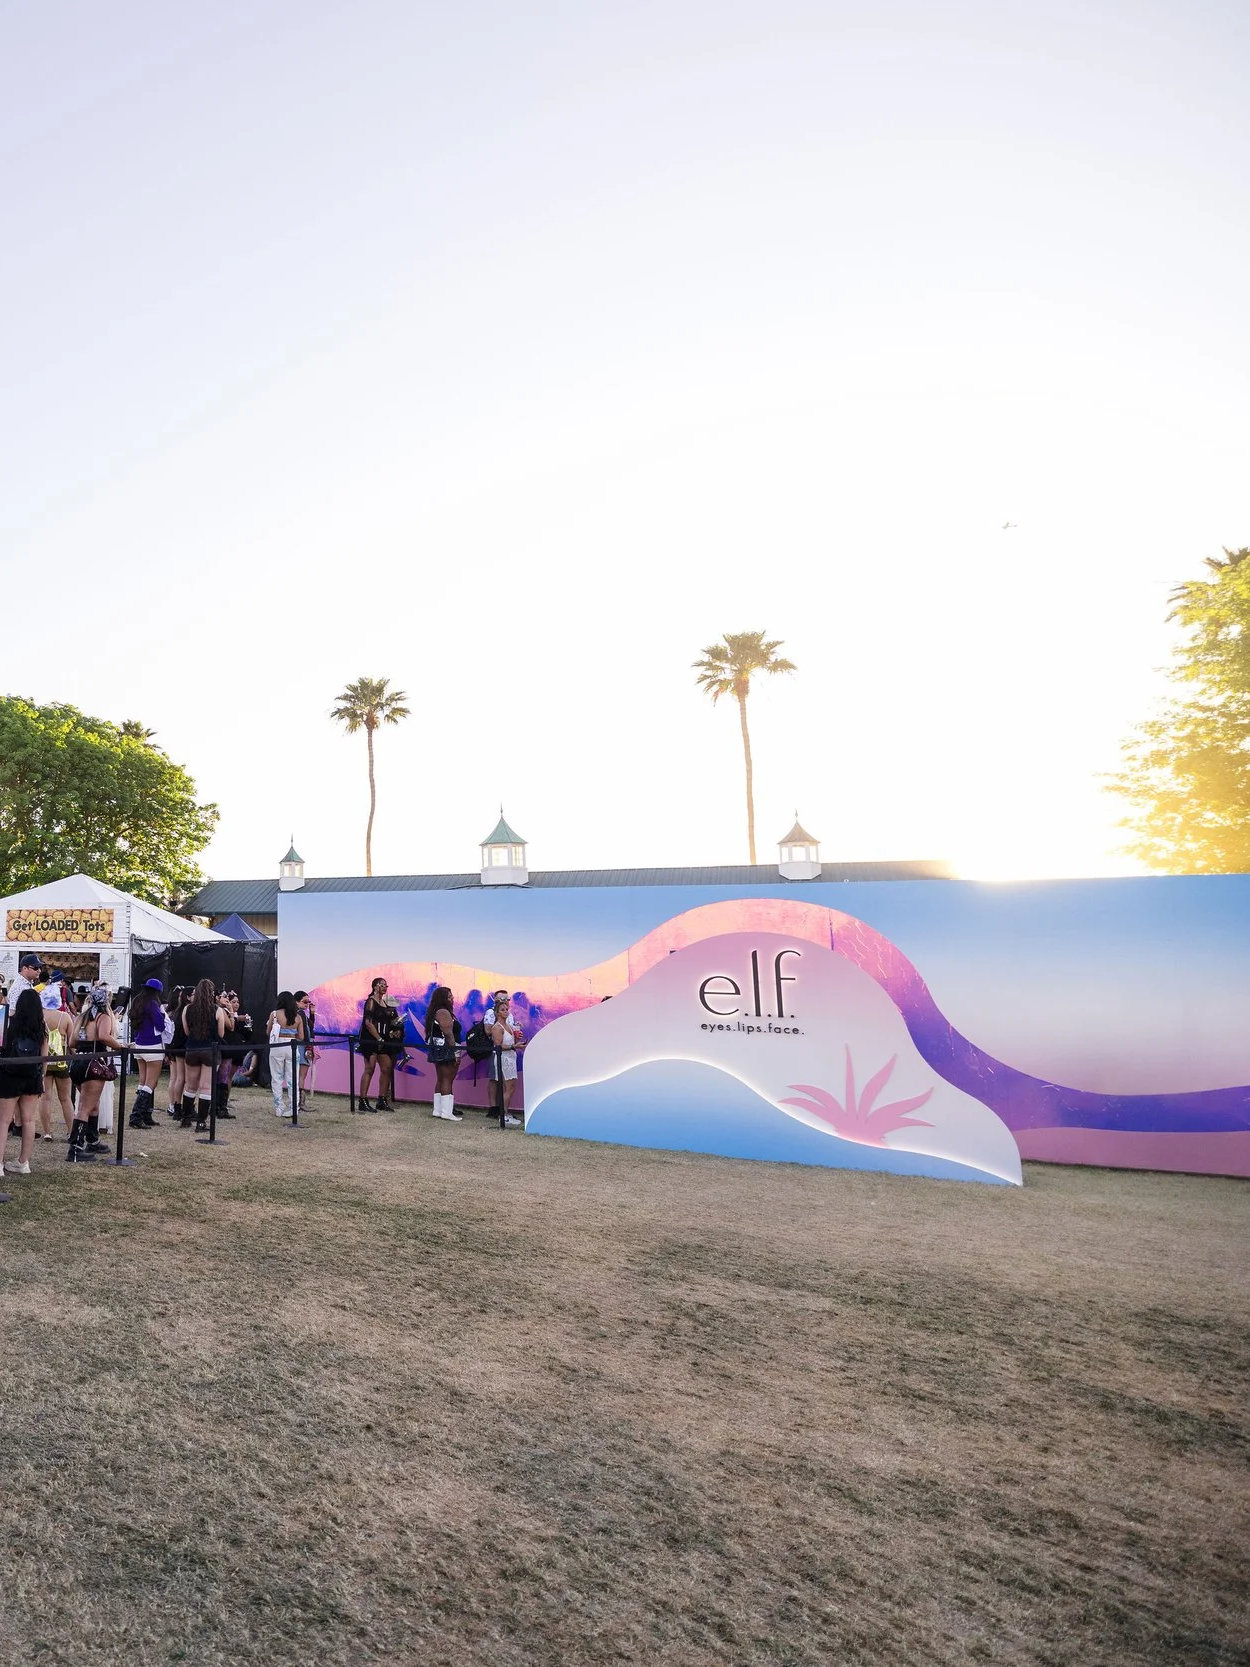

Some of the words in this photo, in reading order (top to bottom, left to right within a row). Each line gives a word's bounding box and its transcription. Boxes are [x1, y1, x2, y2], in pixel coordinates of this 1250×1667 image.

[12, 919, 32, 932] Get
[35, 919, 79, 932] LOADED
[83, 919, 106, 932] Tots
[698, 949, 802, 1019] e.l.f.
[700, 1021, 806, 1036] eyes.lips.face.
